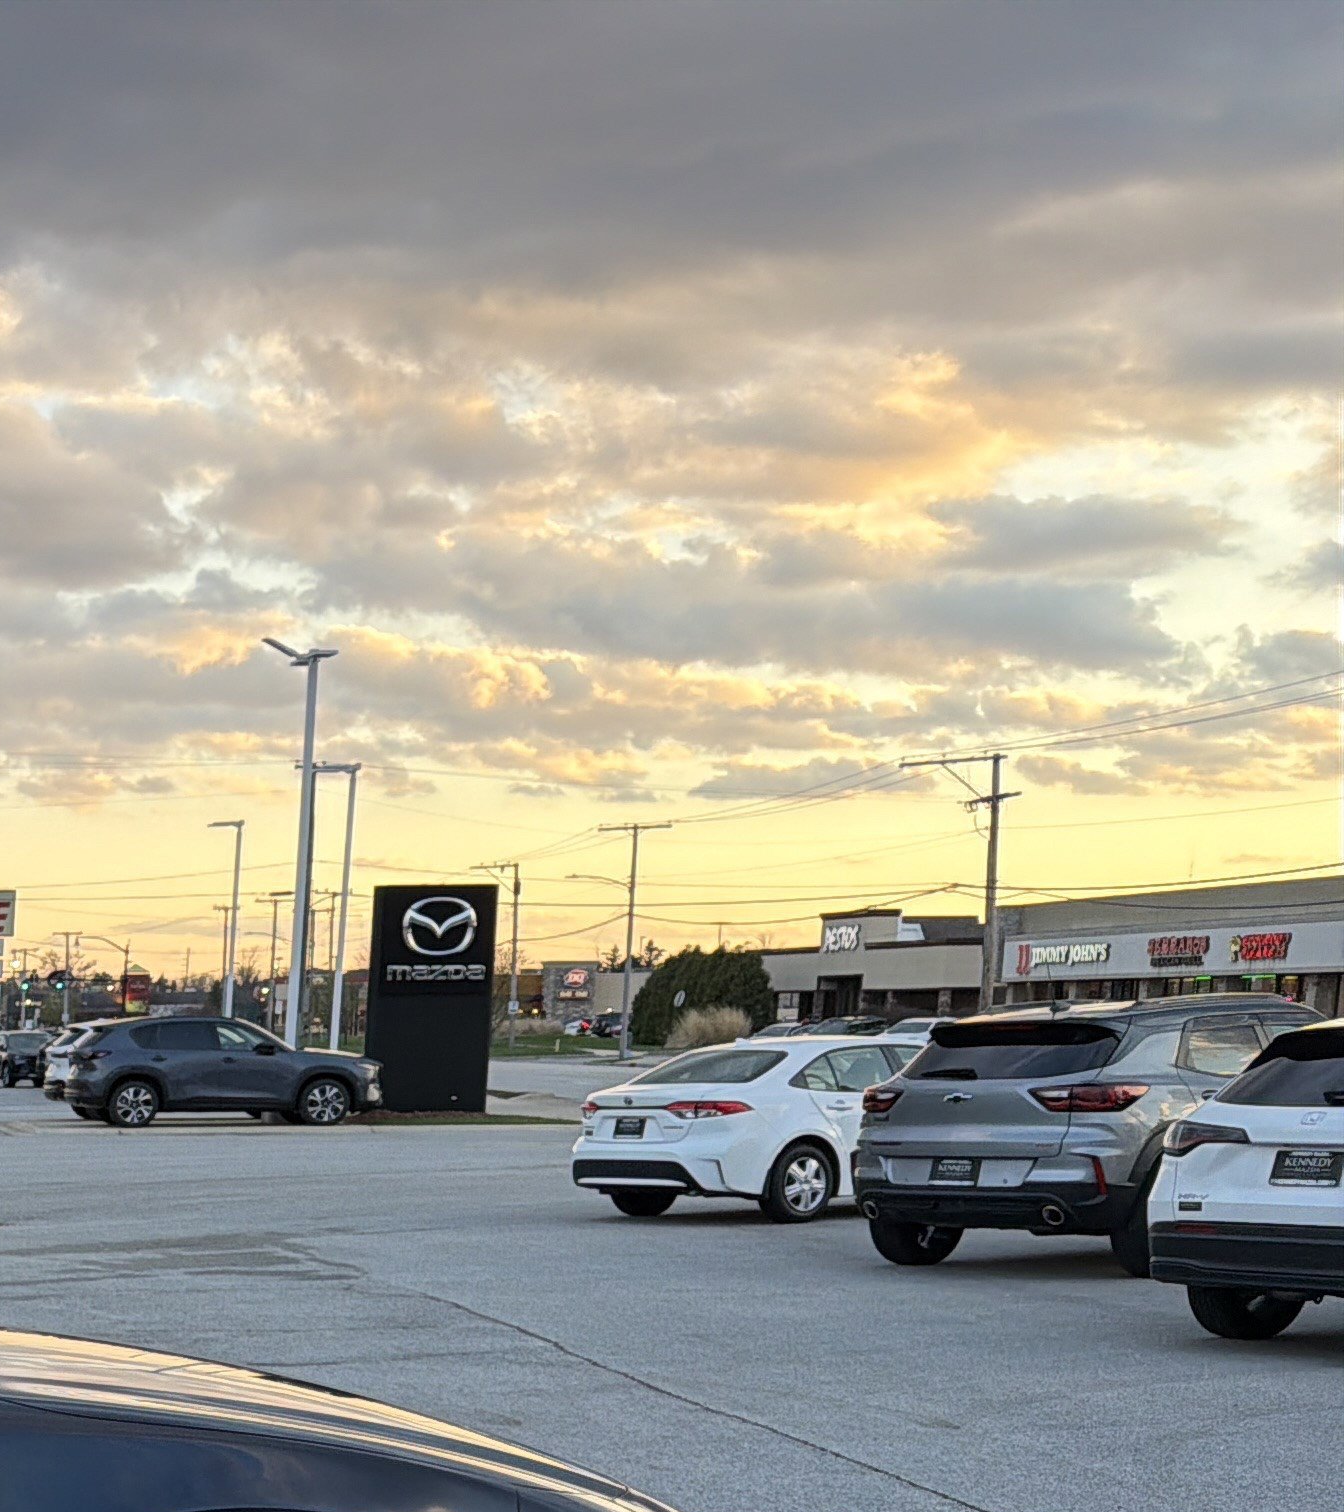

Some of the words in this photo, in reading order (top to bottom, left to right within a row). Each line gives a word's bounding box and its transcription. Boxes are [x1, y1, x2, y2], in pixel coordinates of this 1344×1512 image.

[1031, 946, 1068, 967] JIMMY
[1067, 943, 1109, 966] JOHN'S
[1284, 1157, 1335, 1167] KENNEDY
